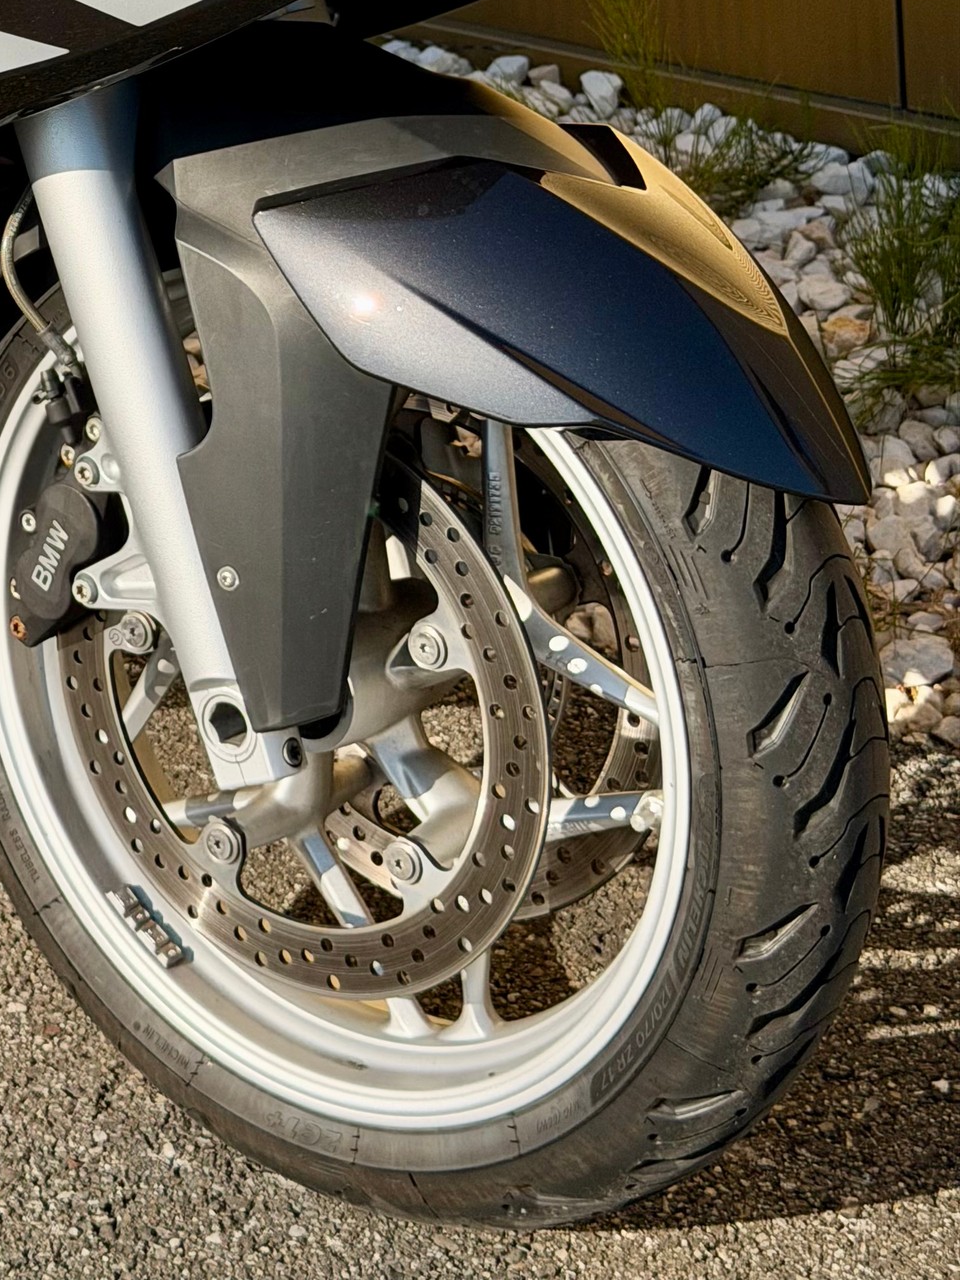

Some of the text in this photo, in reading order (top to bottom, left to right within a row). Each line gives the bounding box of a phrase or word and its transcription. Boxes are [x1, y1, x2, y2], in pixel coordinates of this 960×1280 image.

[2, 361, 16, 380] 6
[31, 519, 69, 592] BMW
[635, 983, 672, 1048] 120/70
[617, 1044, 634, 1071] ZR
[600, 1067, 616, 1090] 17
